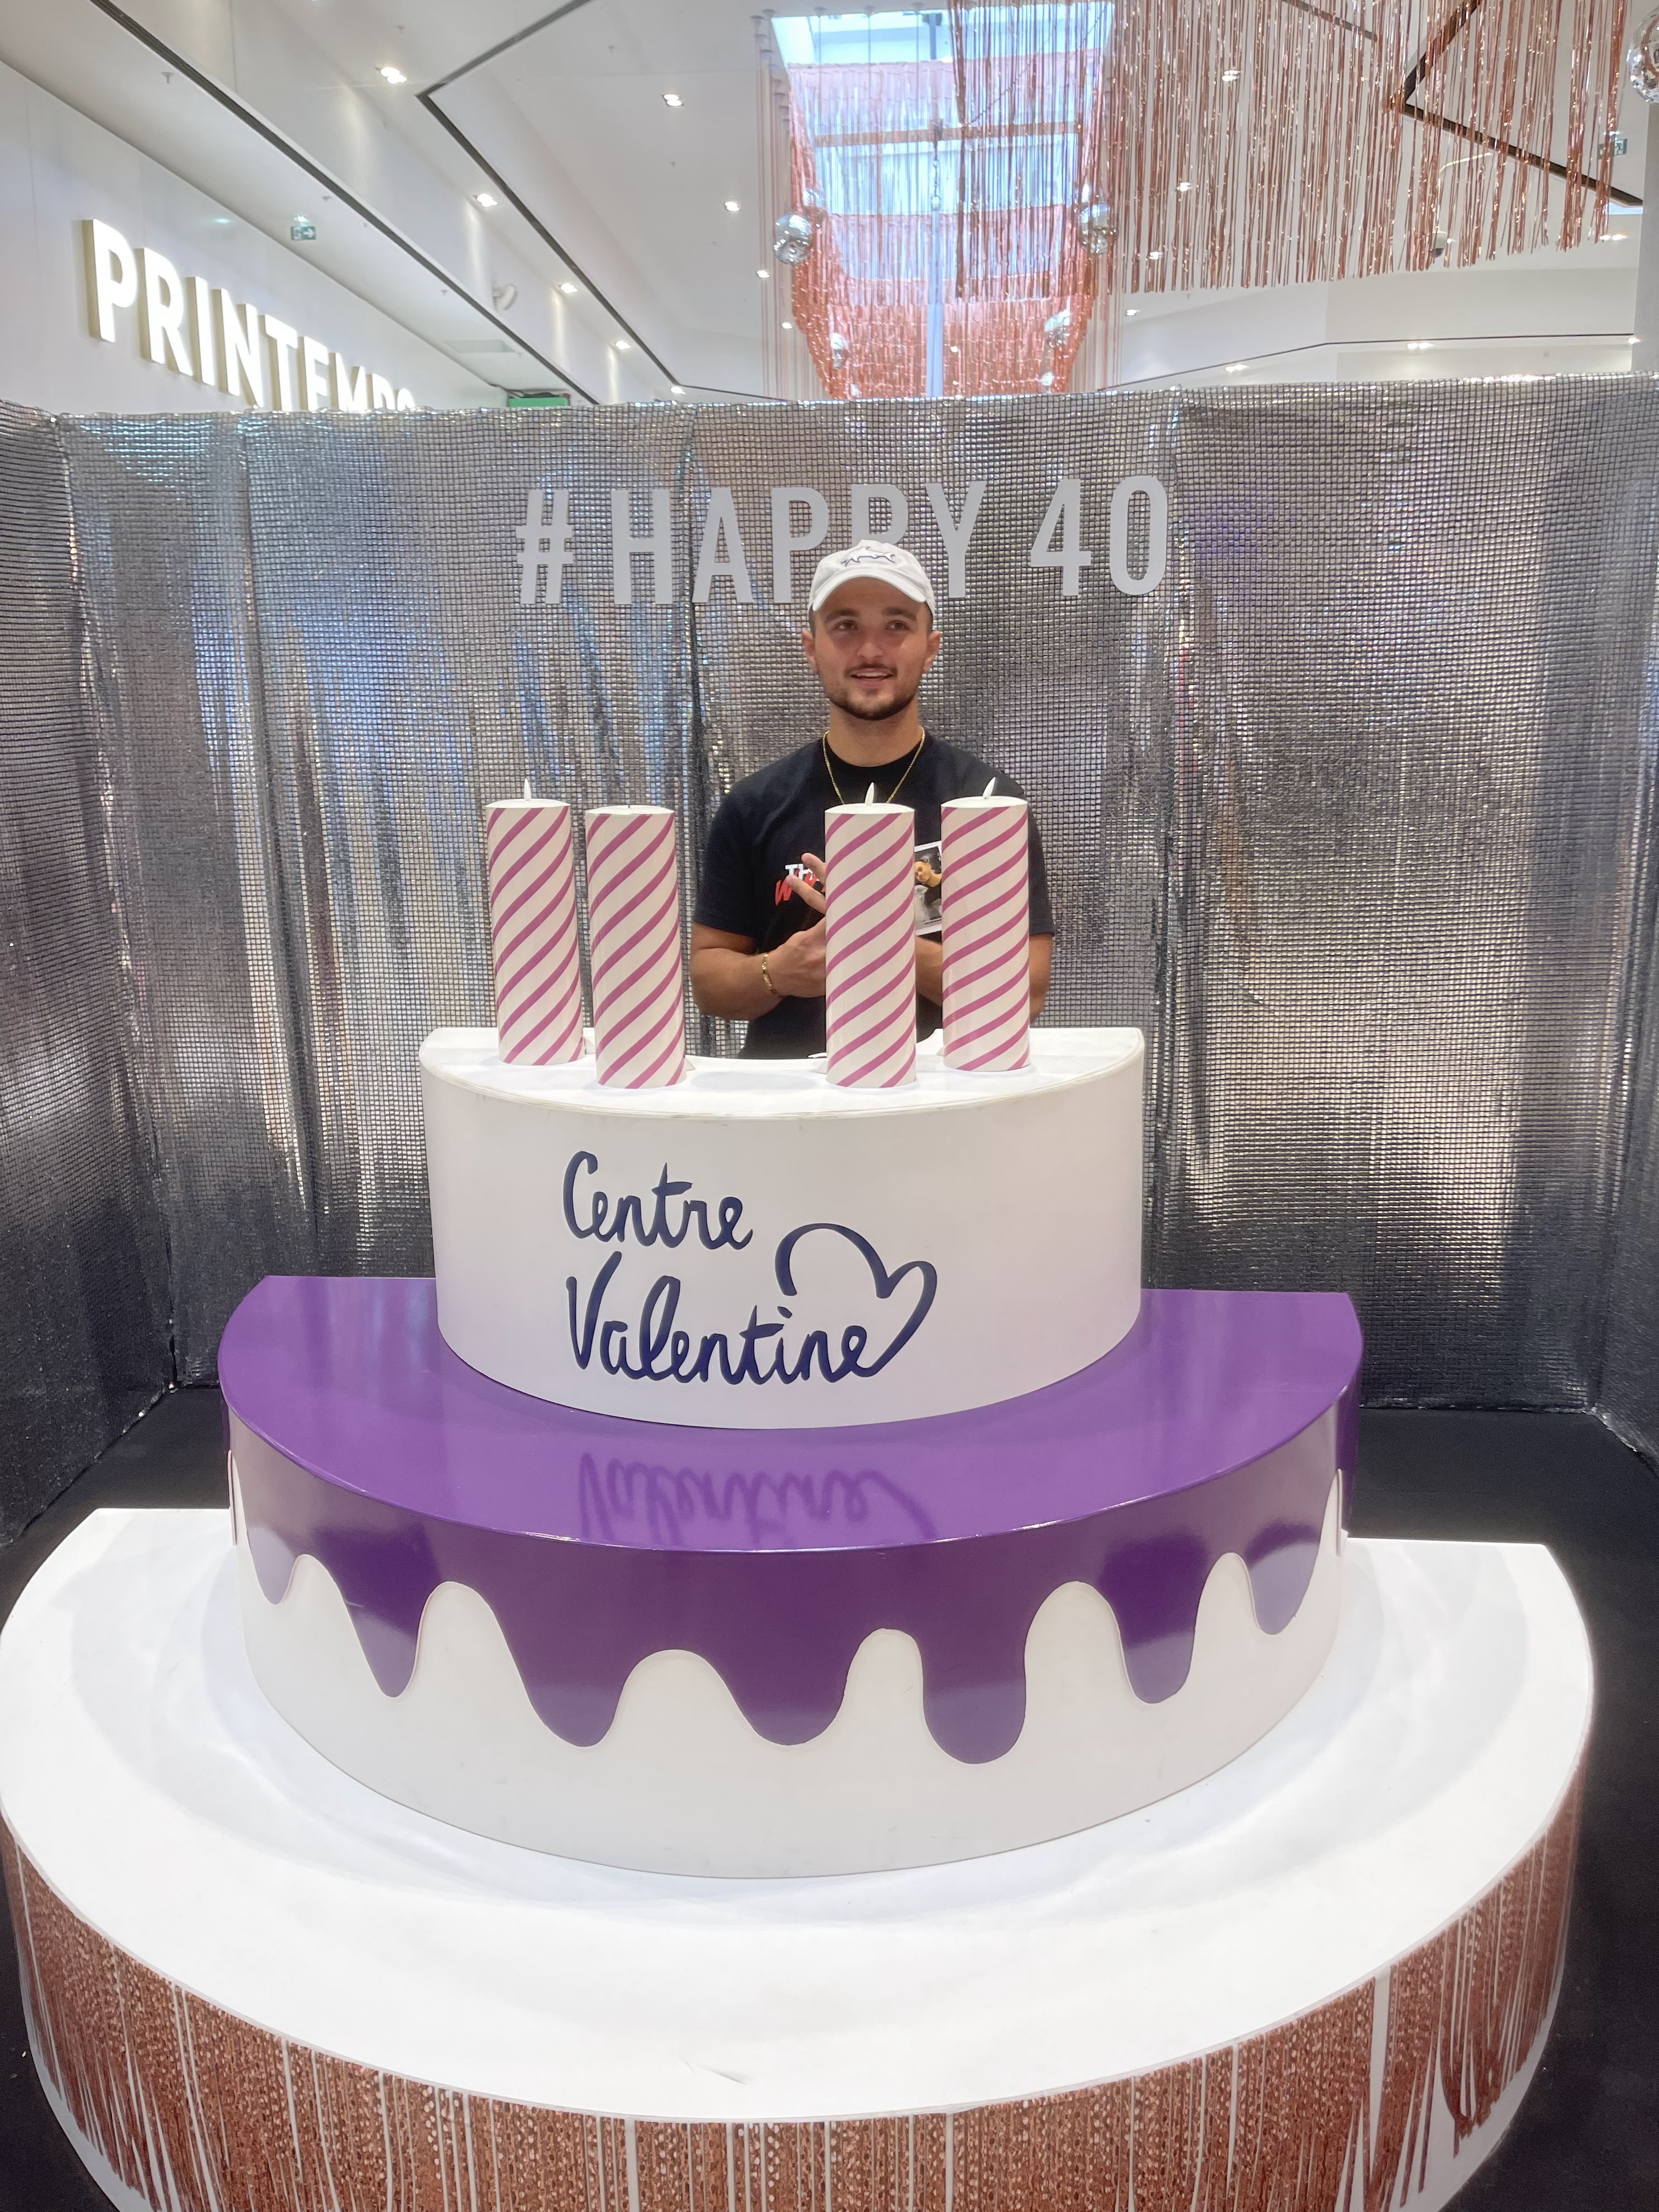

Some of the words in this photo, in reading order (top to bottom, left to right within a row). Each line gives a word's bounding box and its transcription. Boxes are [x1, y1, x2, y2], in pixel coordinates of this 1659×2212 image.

[82, 218, 416, 411] PRINTEM
[1030, 475, 1168, 596] 40
[563, 1150, 753, 1250] Centre
[566, 1251, 884, 1385] Valentine
